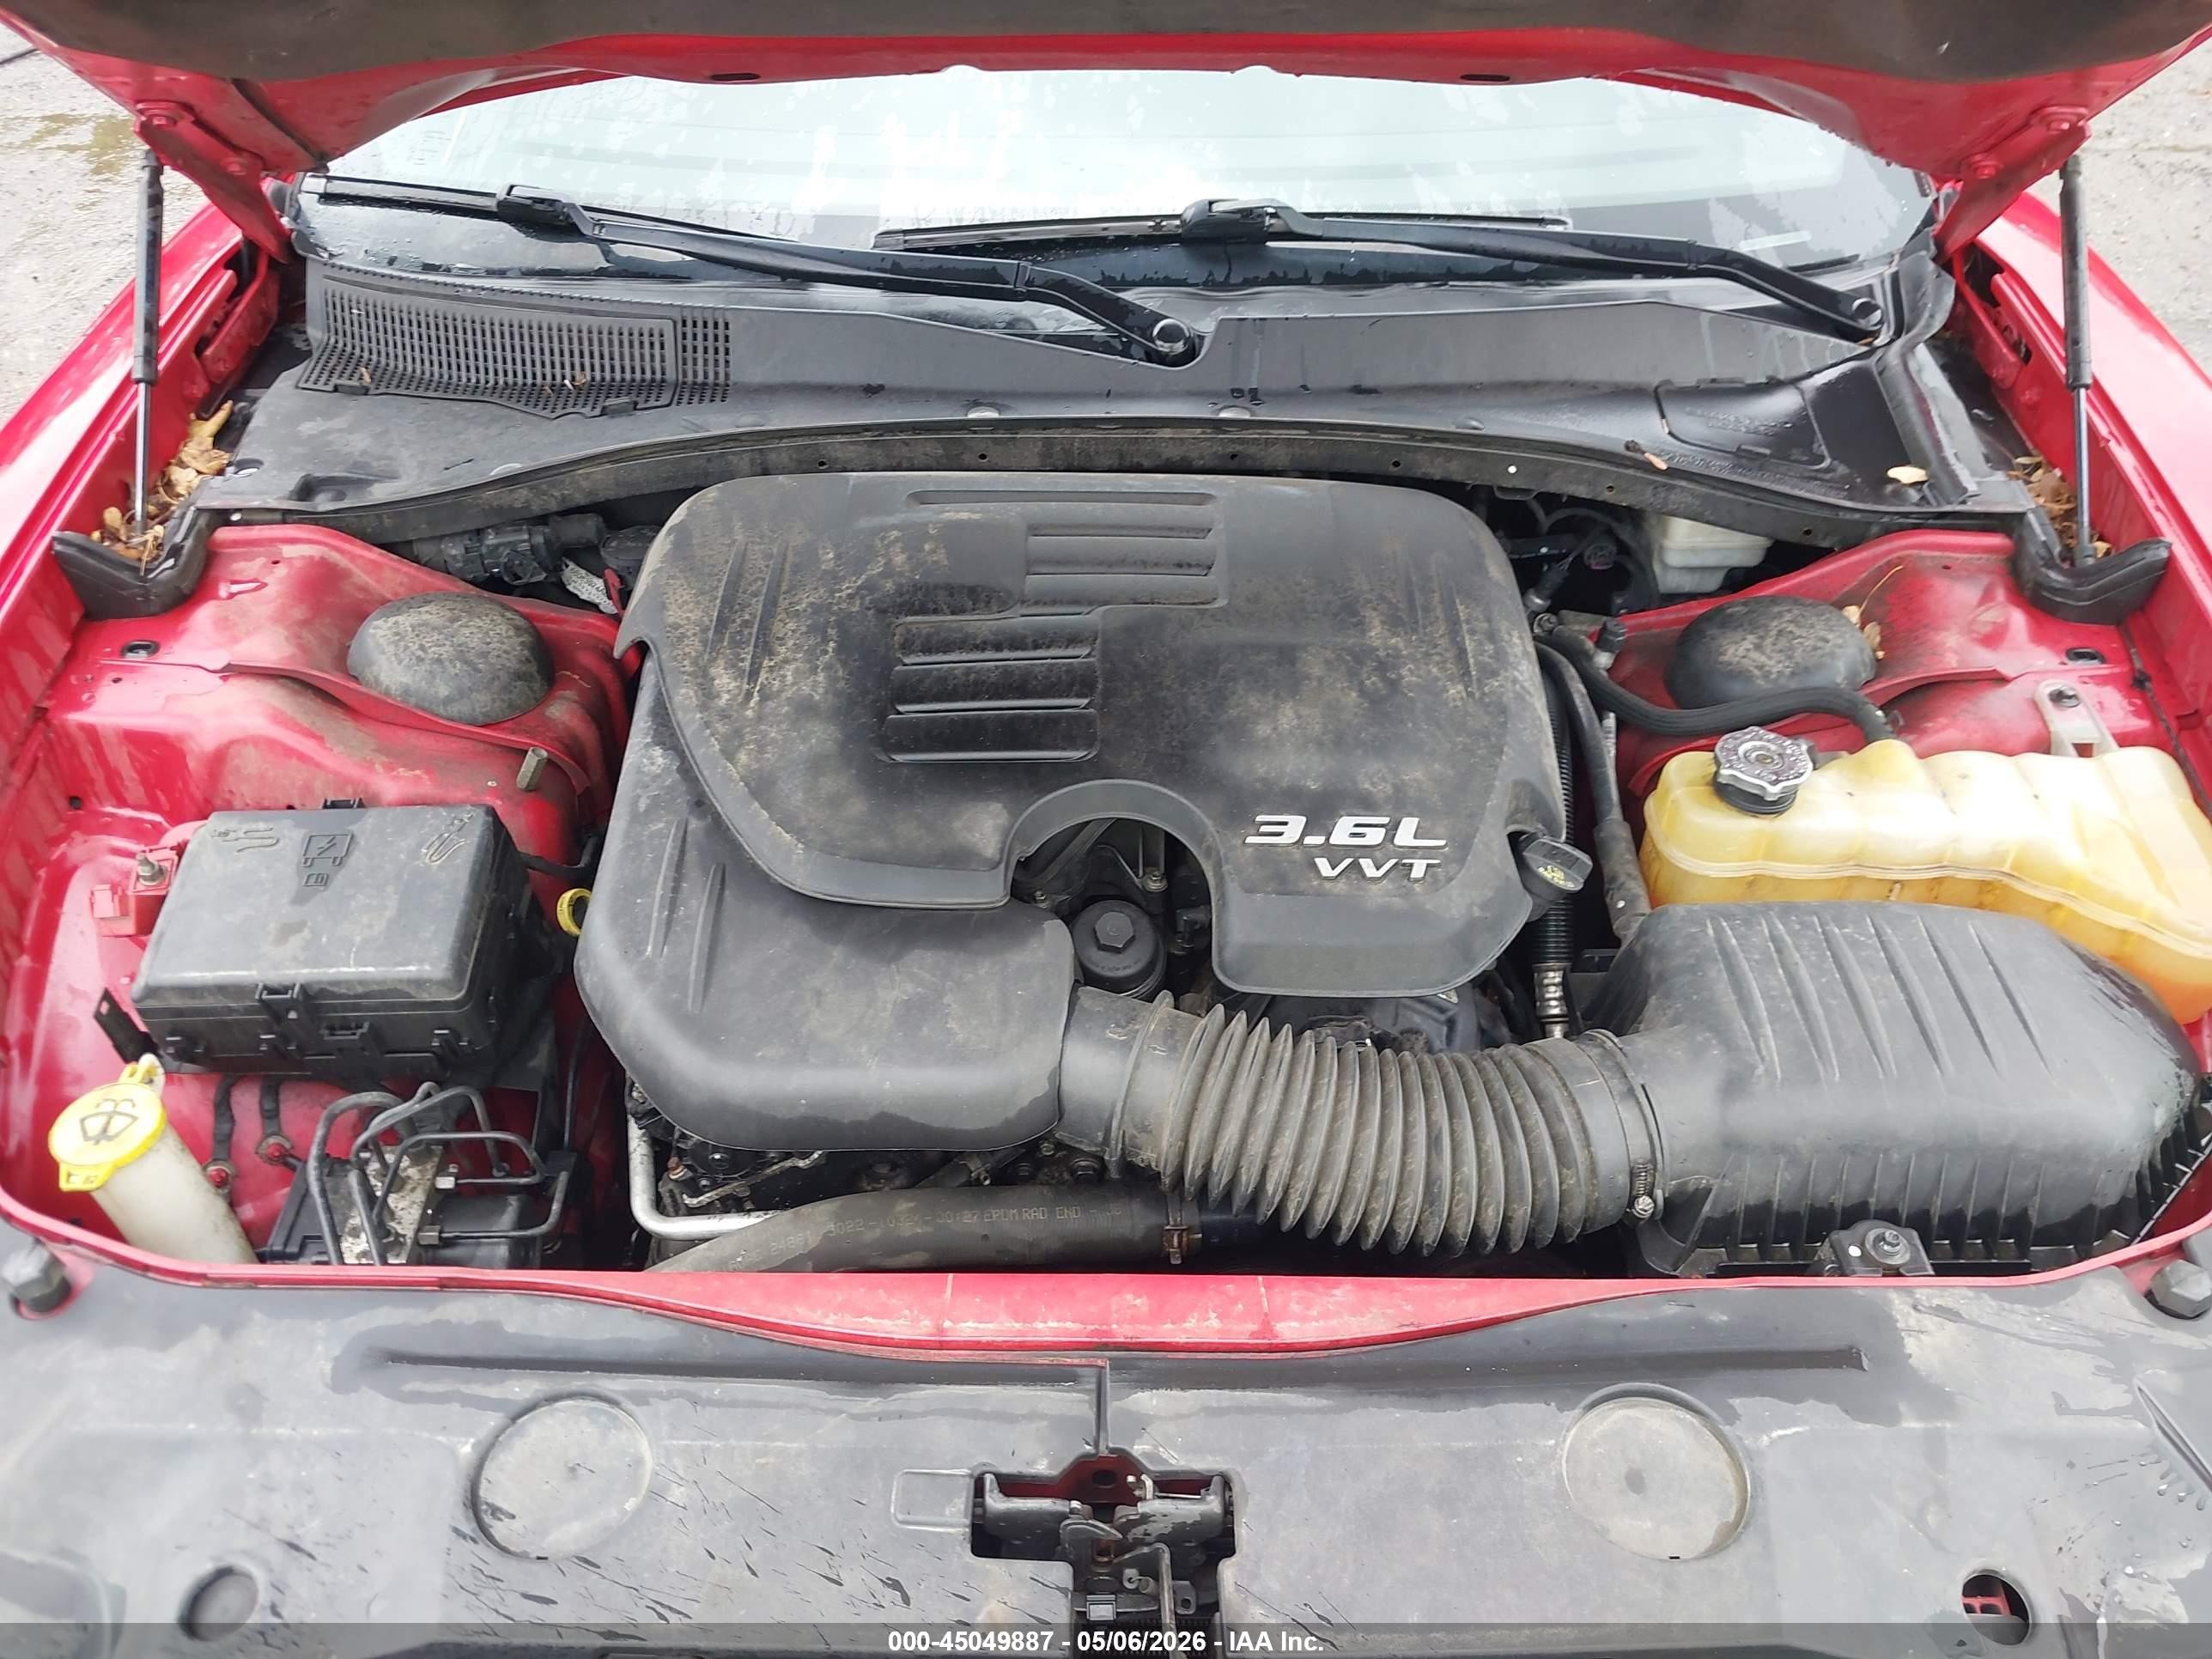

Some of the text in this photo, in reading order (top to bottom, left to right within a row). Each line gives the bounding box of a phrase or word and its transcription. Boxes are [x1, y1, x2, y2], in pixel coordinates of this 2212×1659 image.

[1244, 814, 1447, 847] 3.6L
[1314, 857, 1441, 880] VVT
[1022, 1206, 1048, 1221] RAD
[1055, 1206, 1082, 1219] END
